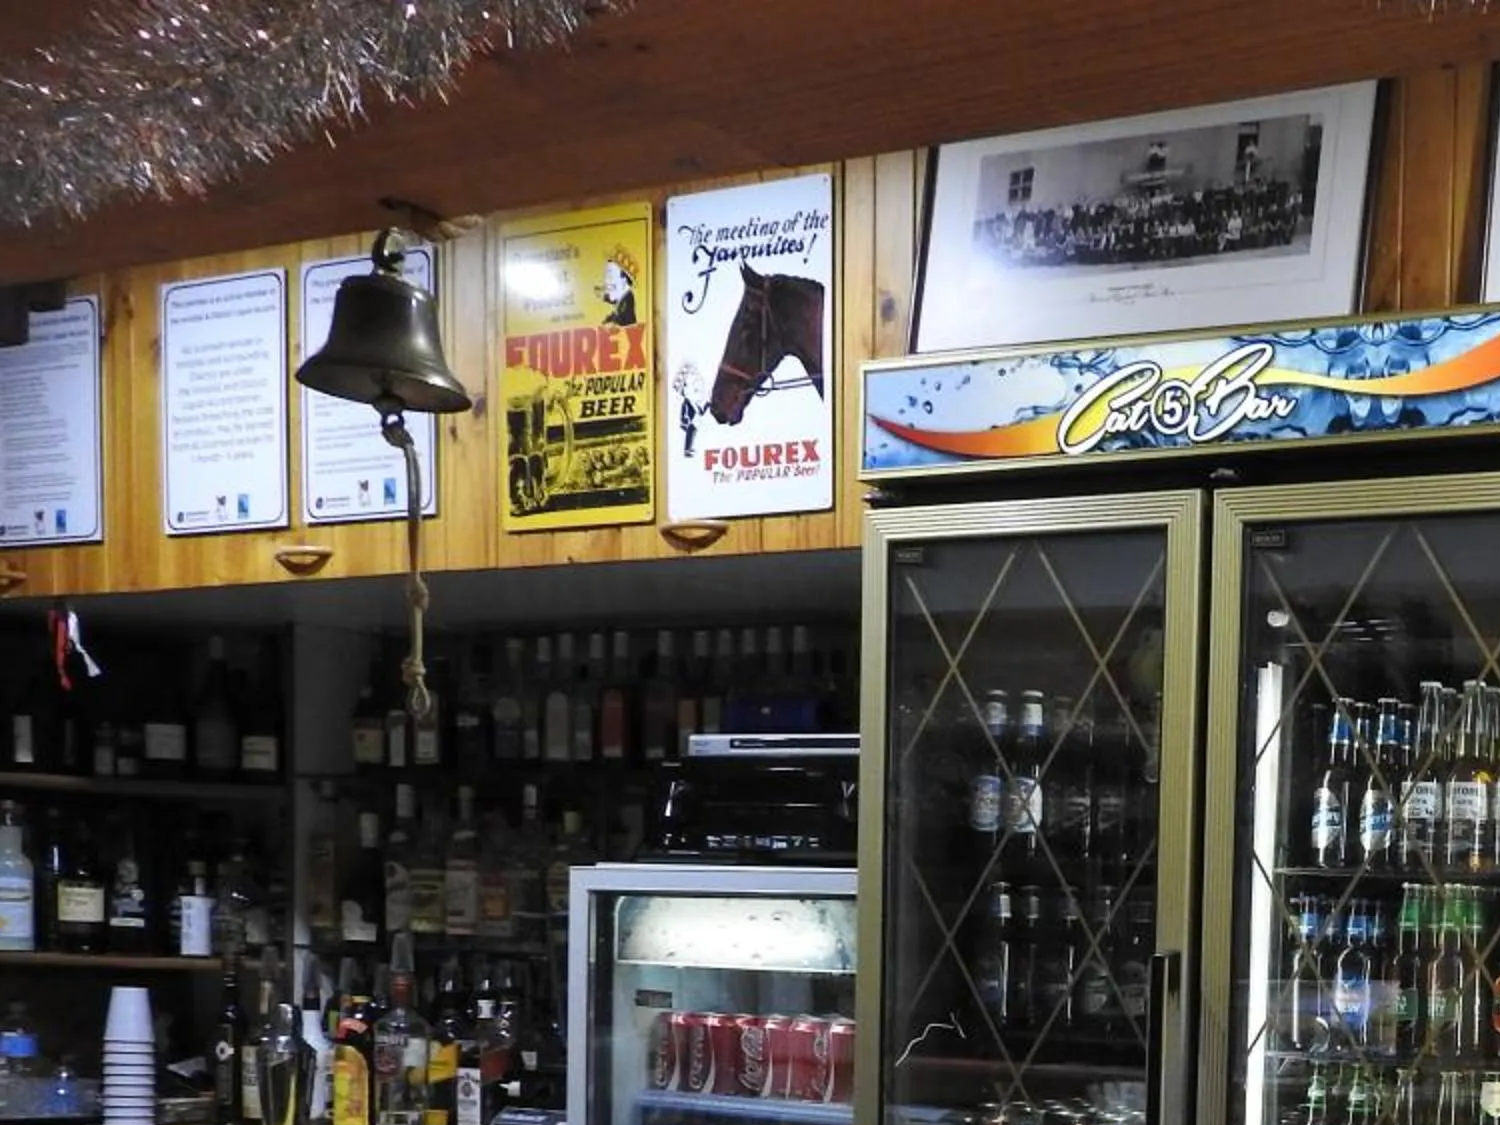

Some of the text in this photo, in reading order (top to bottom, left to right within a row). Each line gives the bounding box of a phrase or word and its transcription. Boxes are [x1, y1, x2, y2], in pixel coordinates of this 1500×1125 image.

[678, 208, 829, 246] The meeting of the
[506, 322, 647, 379] FOUREX
[580, 396, 637, 417] BEER
[1057, 360, 1152, 455] Cat
[1187, 342, 1296, 442] Bar
[704, 439, 820, 471] FOUREX
